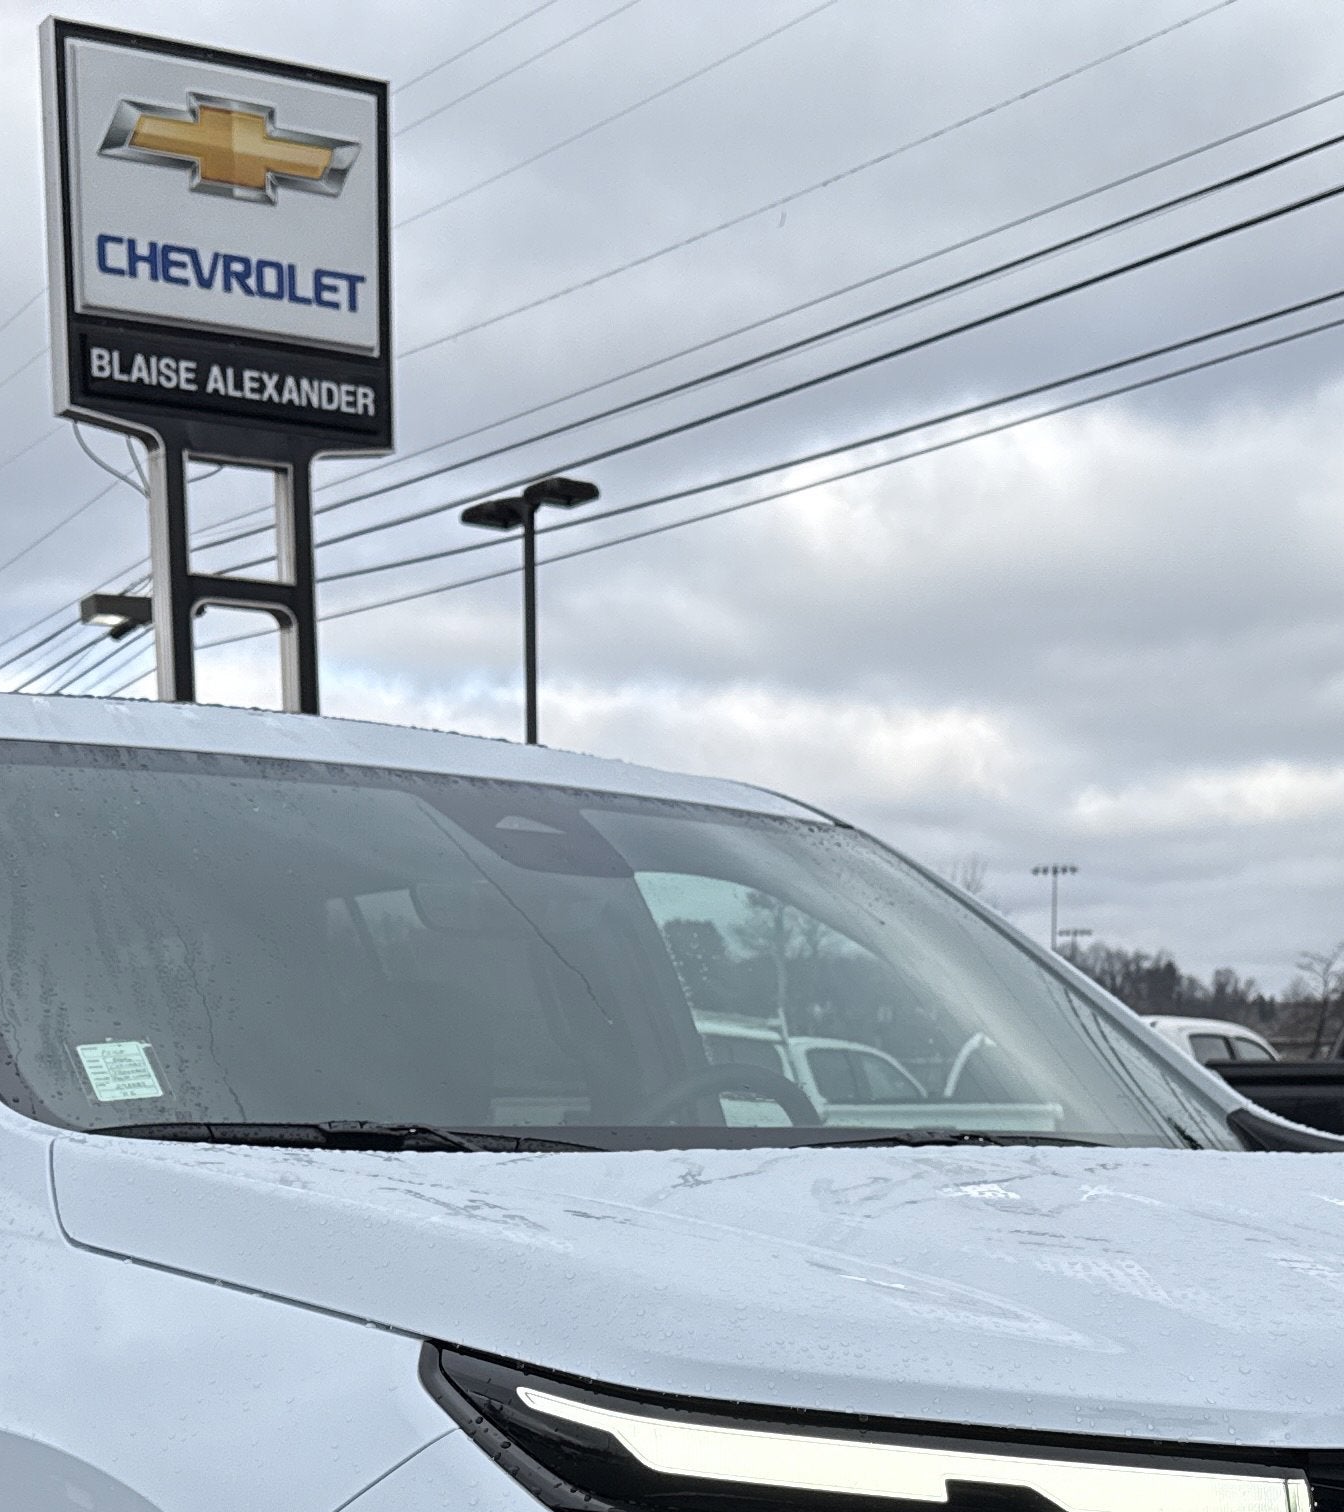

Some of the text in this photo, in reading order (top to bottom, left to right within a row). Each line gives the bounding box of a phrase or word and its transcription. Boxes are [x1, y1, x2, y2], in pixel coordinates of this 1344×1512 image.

[96, 233, 366, 313] CHEVROLET
[89, 347, 376, 416] BLAISE ALEXANDER
